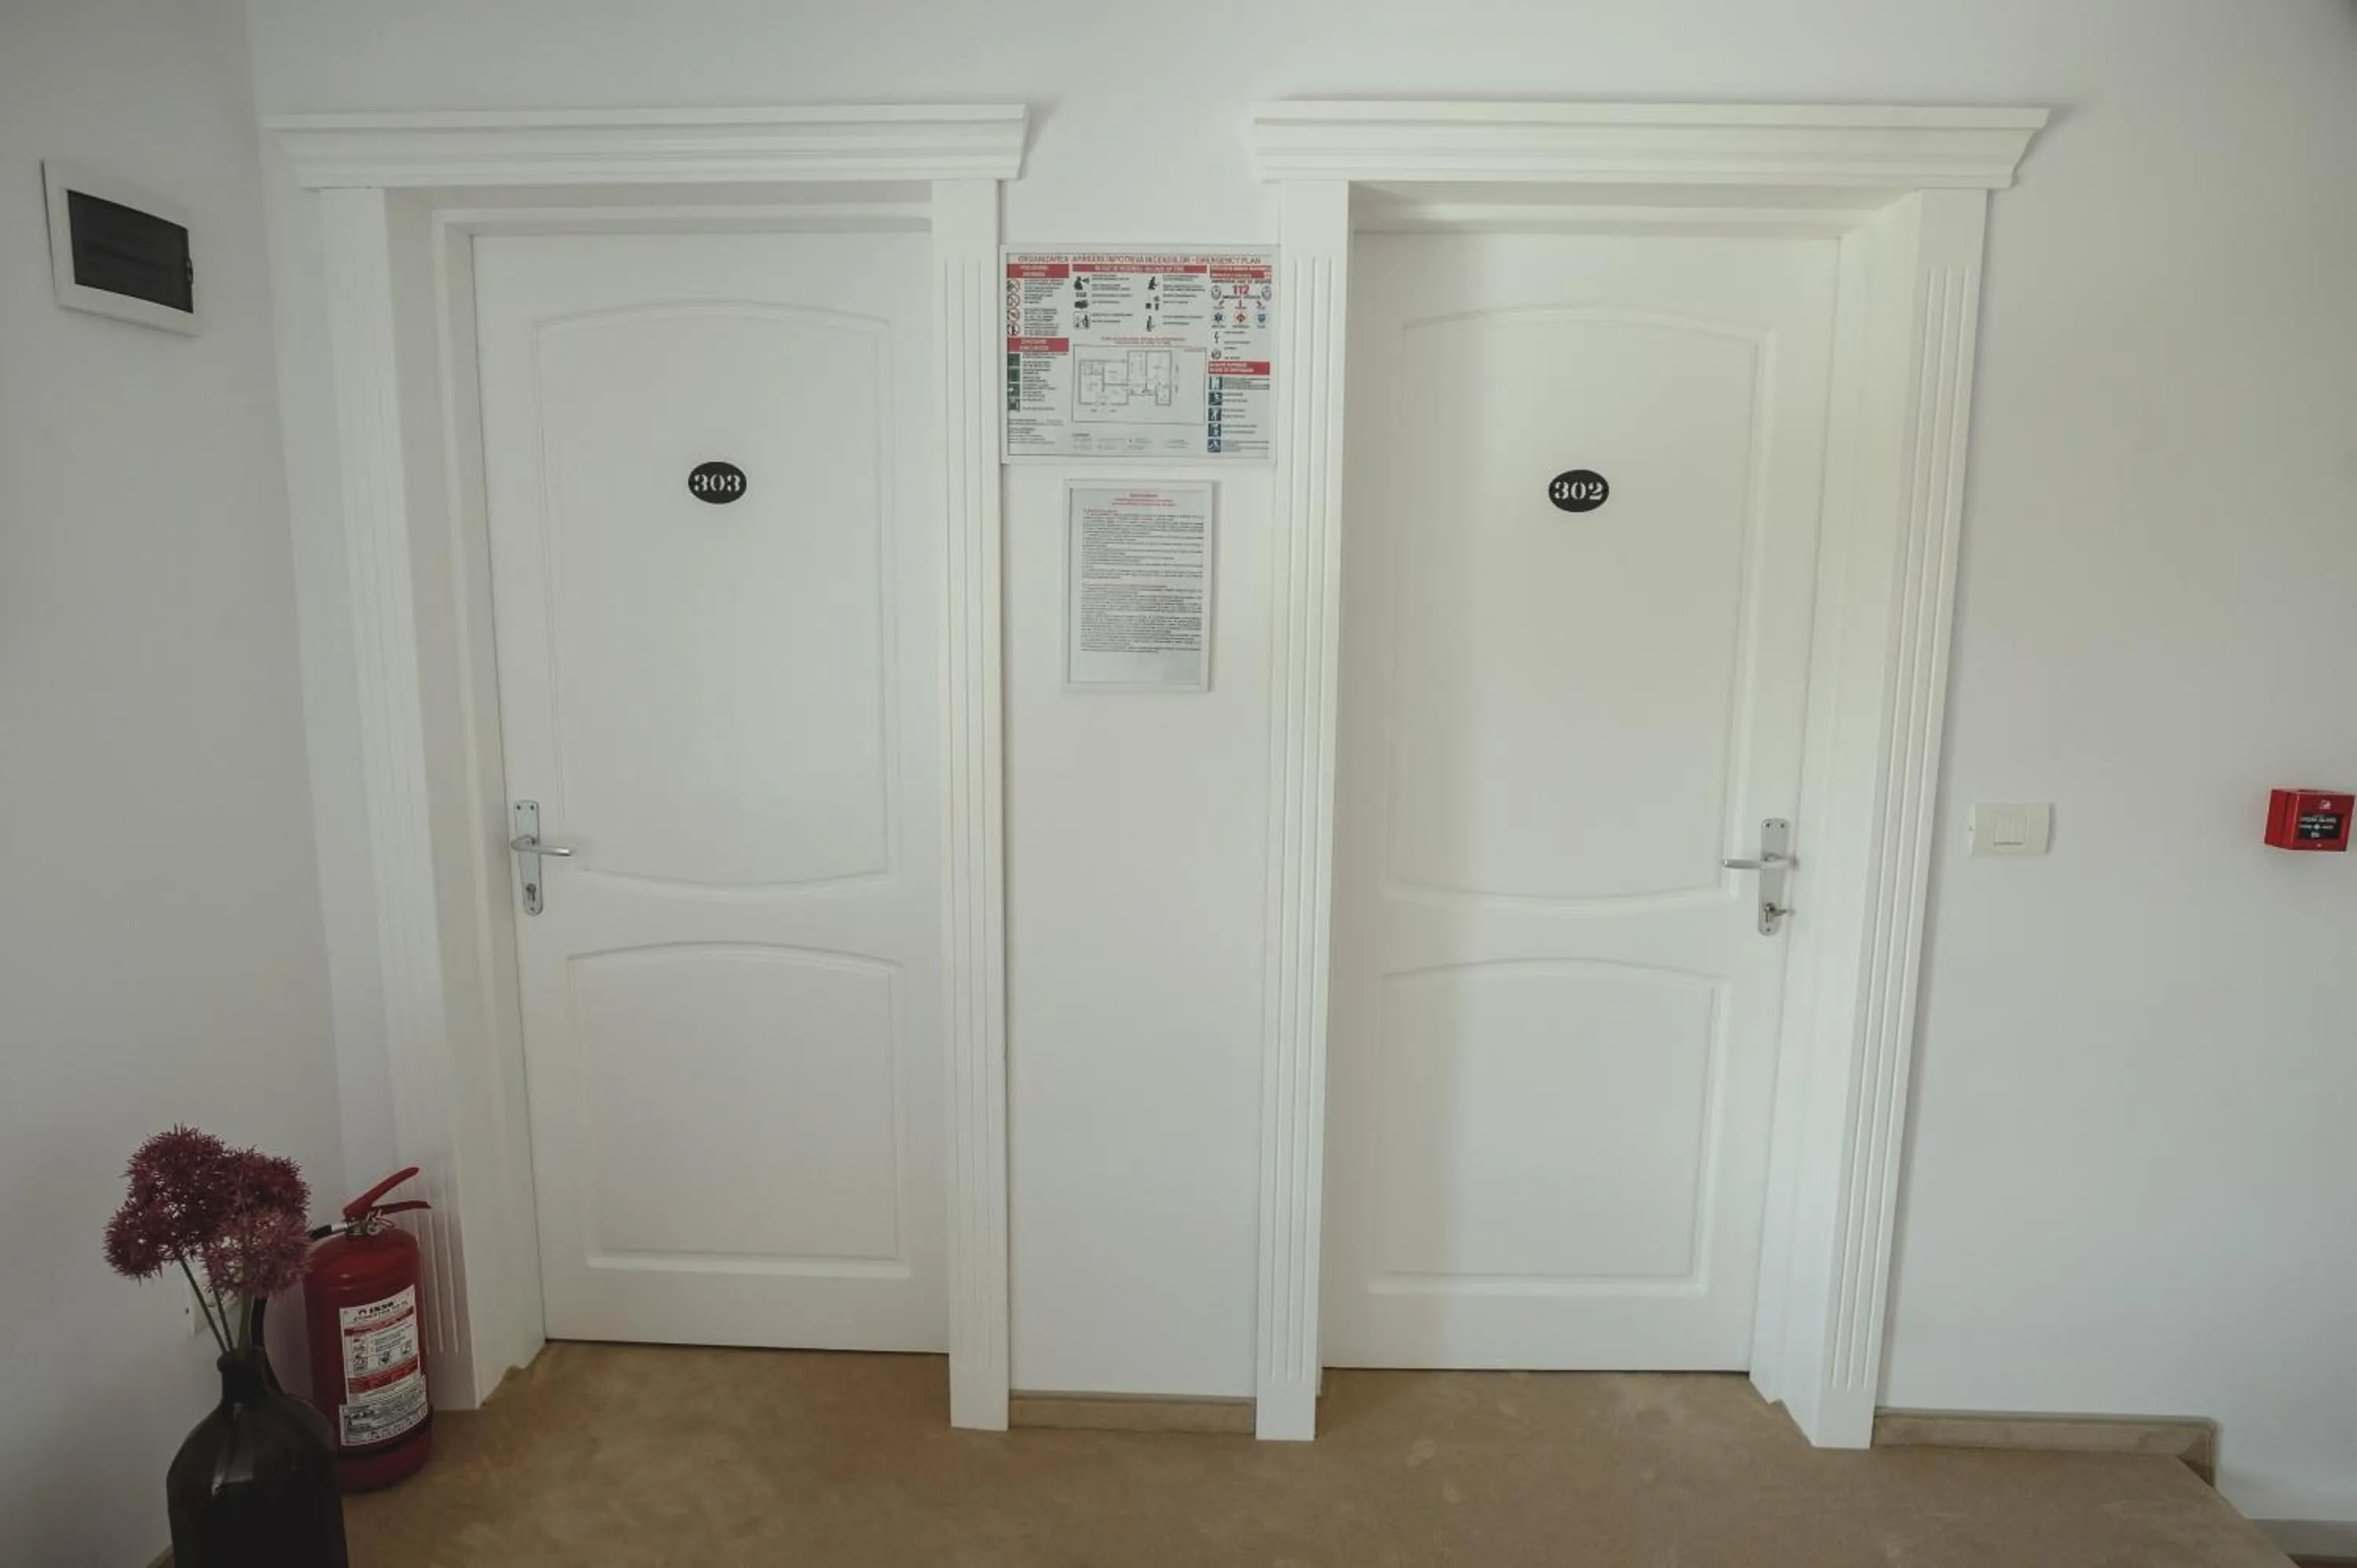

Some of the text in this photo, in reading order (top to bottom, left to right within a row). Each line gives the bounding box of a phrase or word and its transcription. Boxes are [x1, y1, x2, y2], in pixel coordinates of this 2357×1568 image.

[1232, 285, 1250, 295] 112
[693, 474, 741, 492] 303
[1554, 481, 1604, 500] 302
